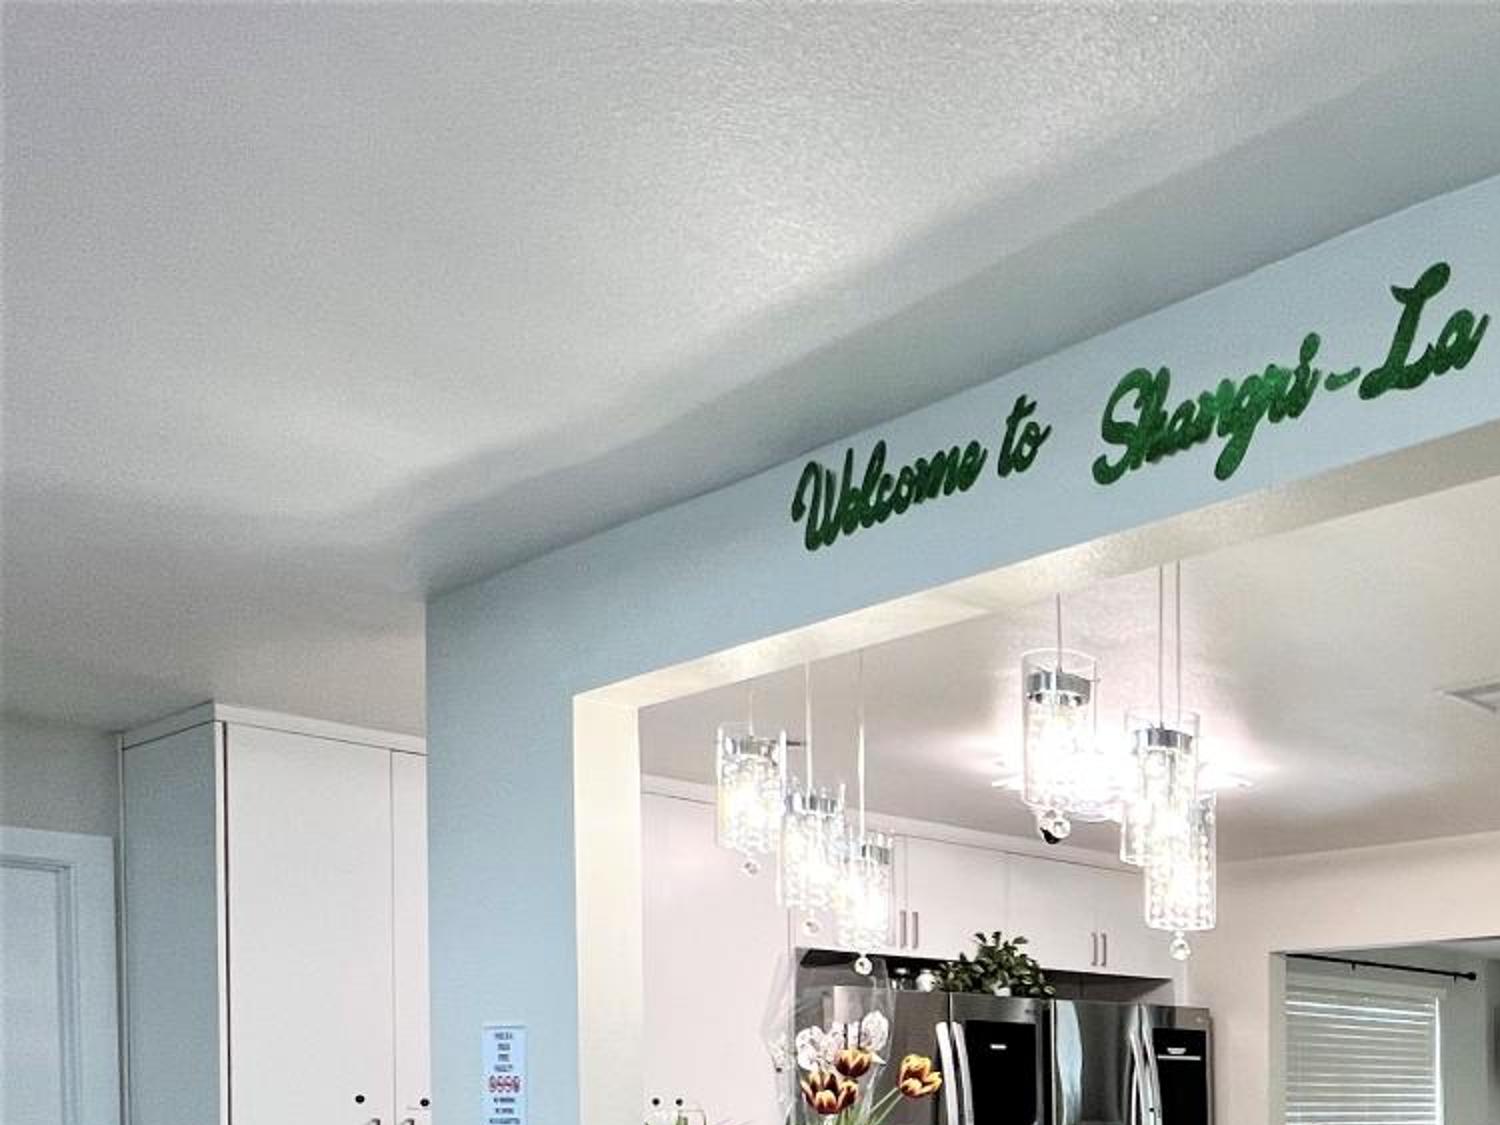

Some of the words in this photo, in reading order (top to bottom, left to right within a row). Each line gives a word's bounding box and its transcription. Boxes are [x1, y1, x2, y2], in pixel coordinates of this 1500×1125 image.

[792, 439, 988, 551] Welcome
[997, 394, 1052, 477] to
[1093, 262, 1489, 486] Shangri-La
